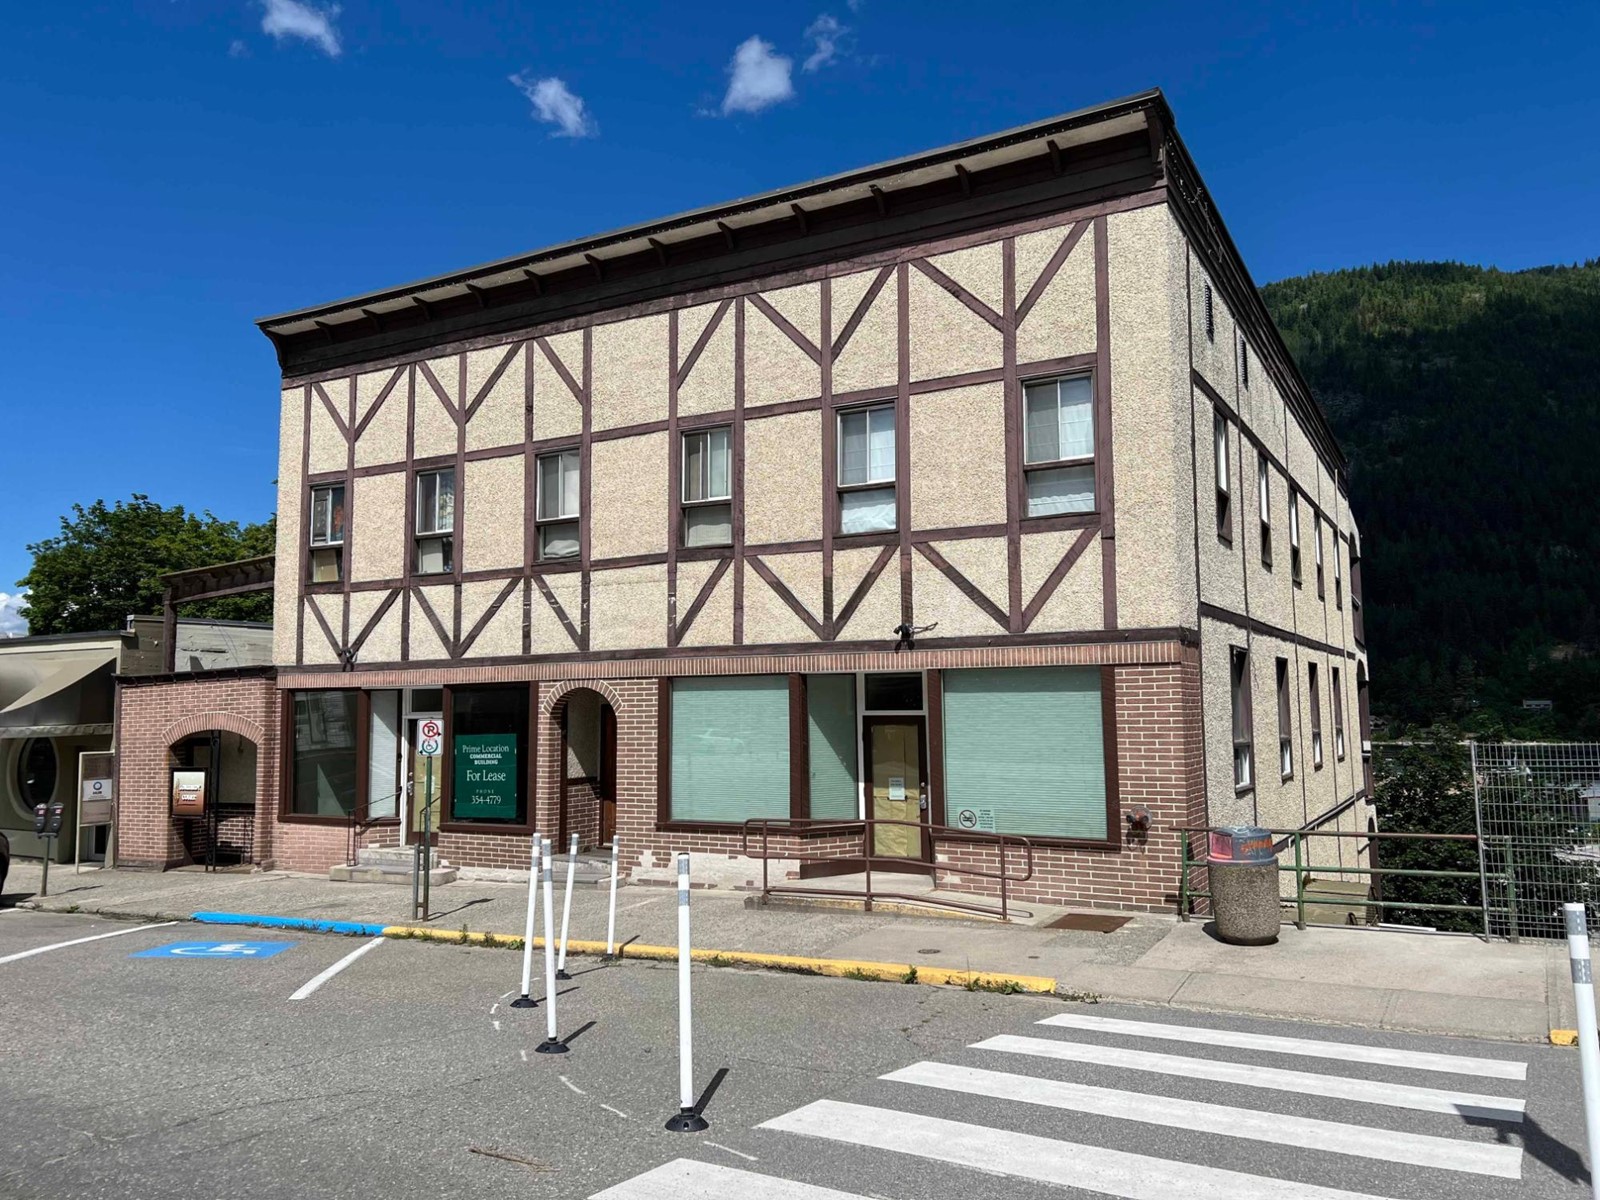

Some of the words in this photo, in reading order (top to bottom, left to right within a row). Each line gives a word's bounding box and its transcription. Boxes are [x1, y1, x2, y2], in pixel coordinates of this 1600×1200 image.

[462, 745, 481, 753] Prime
[482, 744, 509, 753] Location
[466, 770, 481, 781] For
[482, 770, 506, 781] Lease
[471, 795, 502, 804] 354-4779
